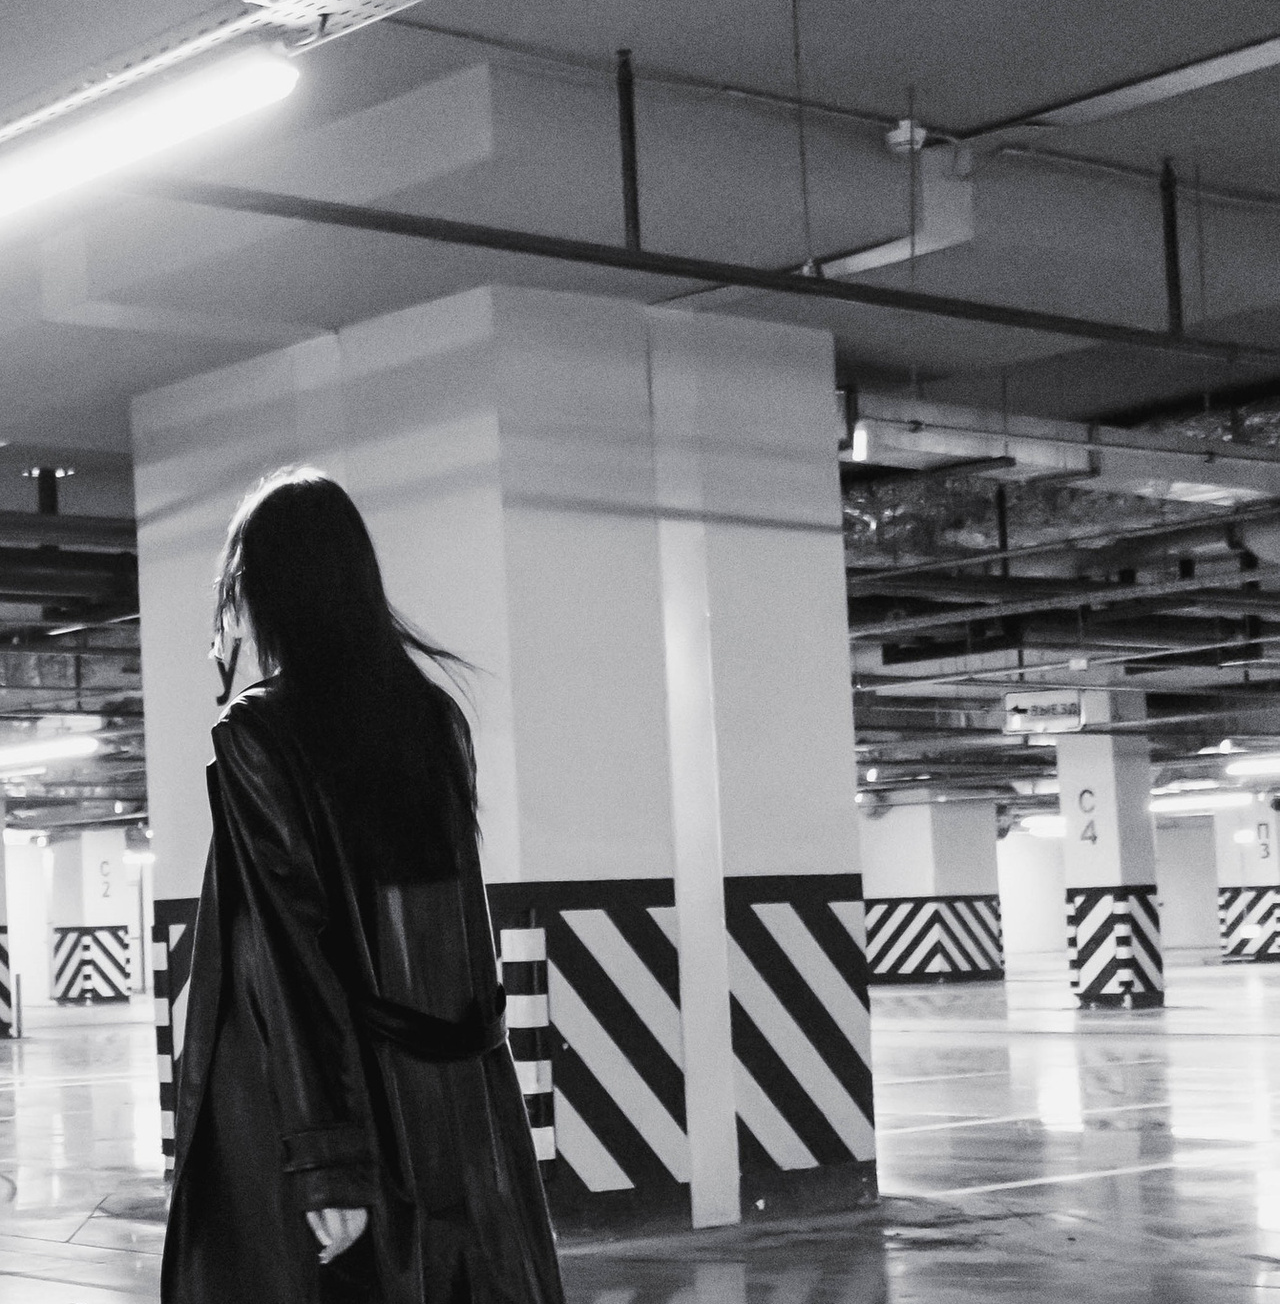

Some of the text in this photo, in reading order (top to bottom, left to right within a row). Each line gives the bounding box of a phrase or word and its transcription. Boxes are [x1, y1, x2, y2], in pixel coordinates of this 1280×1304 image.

[1080, 819, 1098, 845] 4
[1260, 843, 1270, 859] 3
[102, 881, 111, 898] 2
